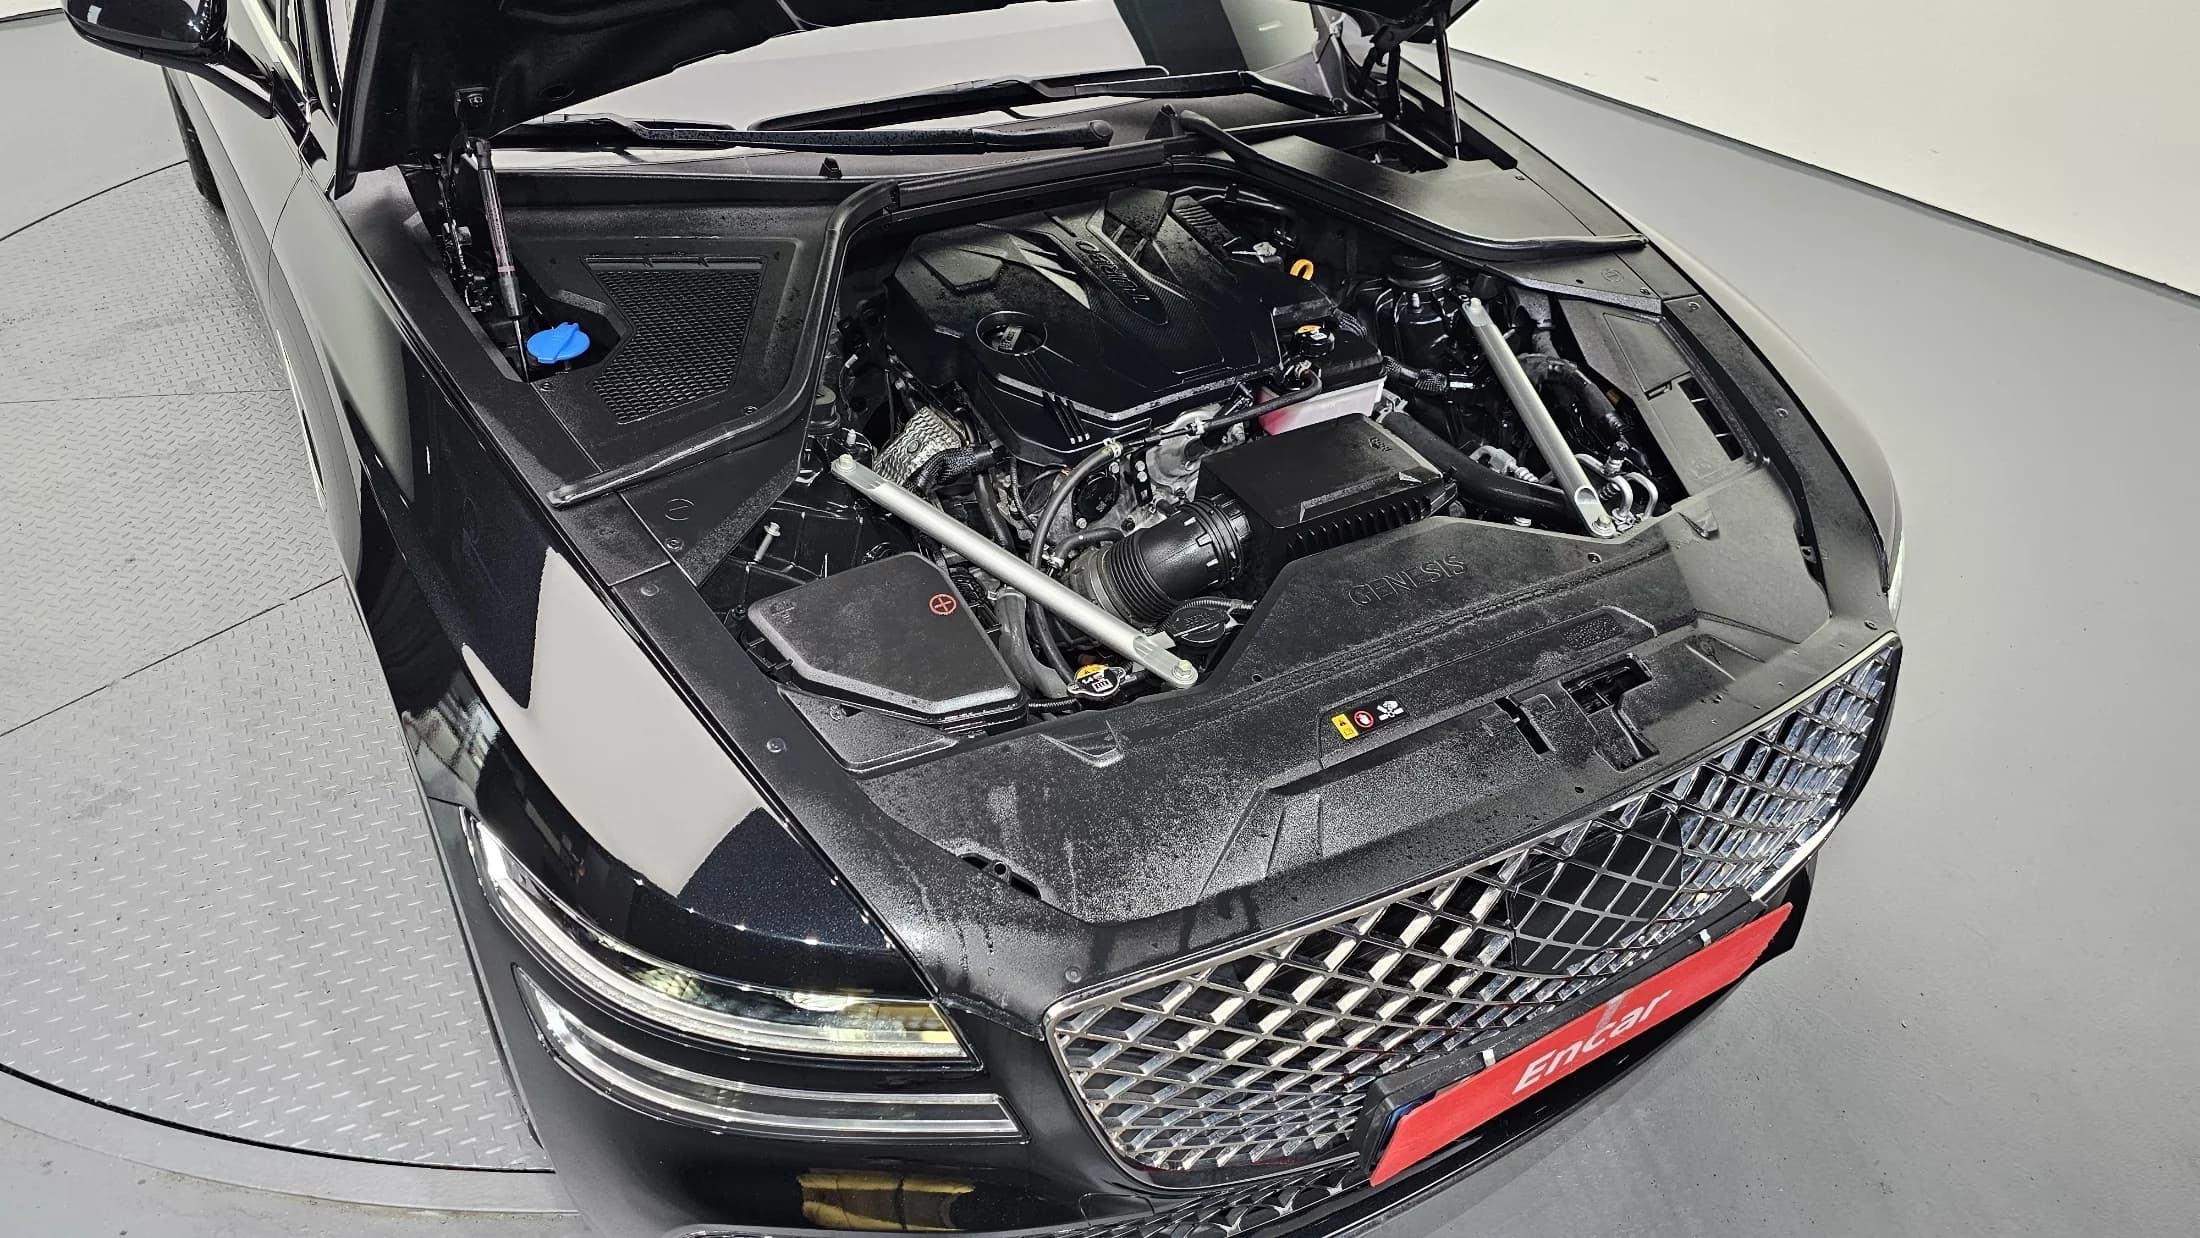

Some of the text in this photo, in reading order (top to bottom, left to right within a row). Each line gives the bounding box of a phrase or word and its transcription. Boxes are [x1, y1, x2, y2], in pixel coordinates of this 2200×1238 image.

[1075, 240, 1150, 304] TURBO
[1348, 554, 1465, 607] GENESIS
[1511, 989, 1673, 1095] Encar
